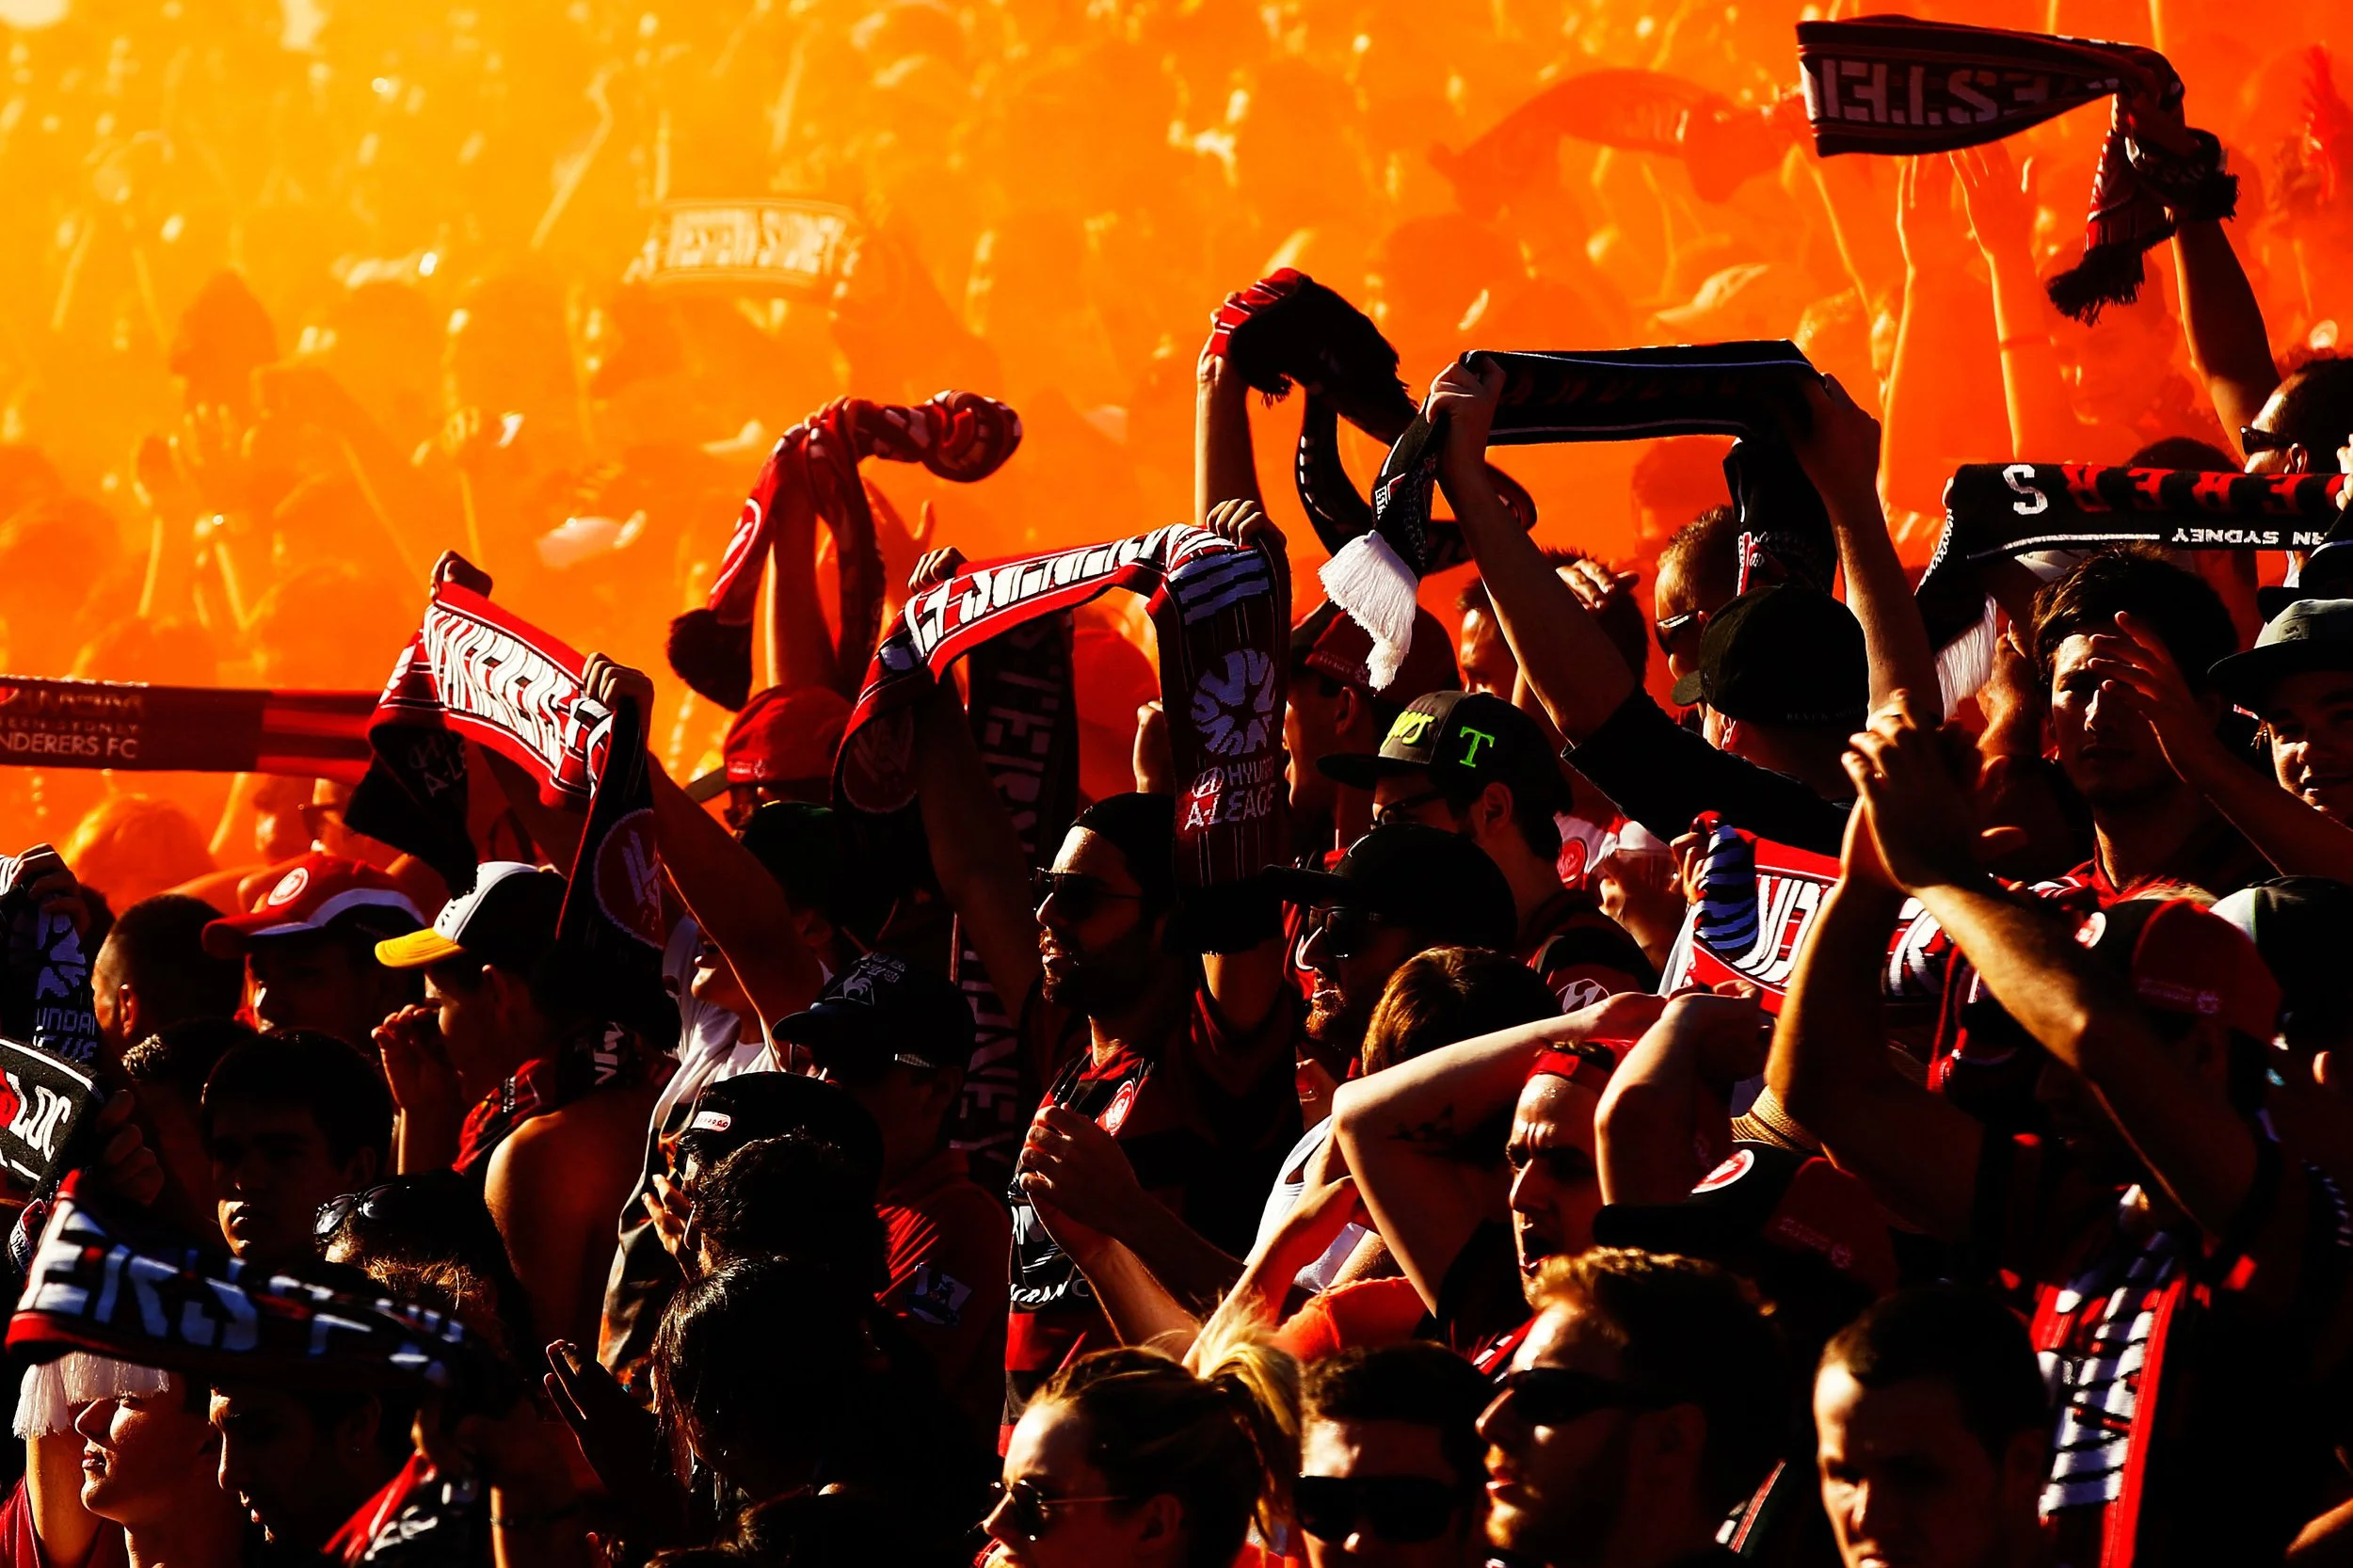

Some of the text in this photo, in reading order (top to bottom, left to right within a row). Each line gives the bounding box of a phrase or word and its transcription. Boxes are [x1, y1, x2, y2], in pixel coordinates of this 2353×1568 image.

[2171, 527, 2280, 546] SYDNEY
[105, 737, 139, 759] FC
[1459, 726, 1496, 768] T
